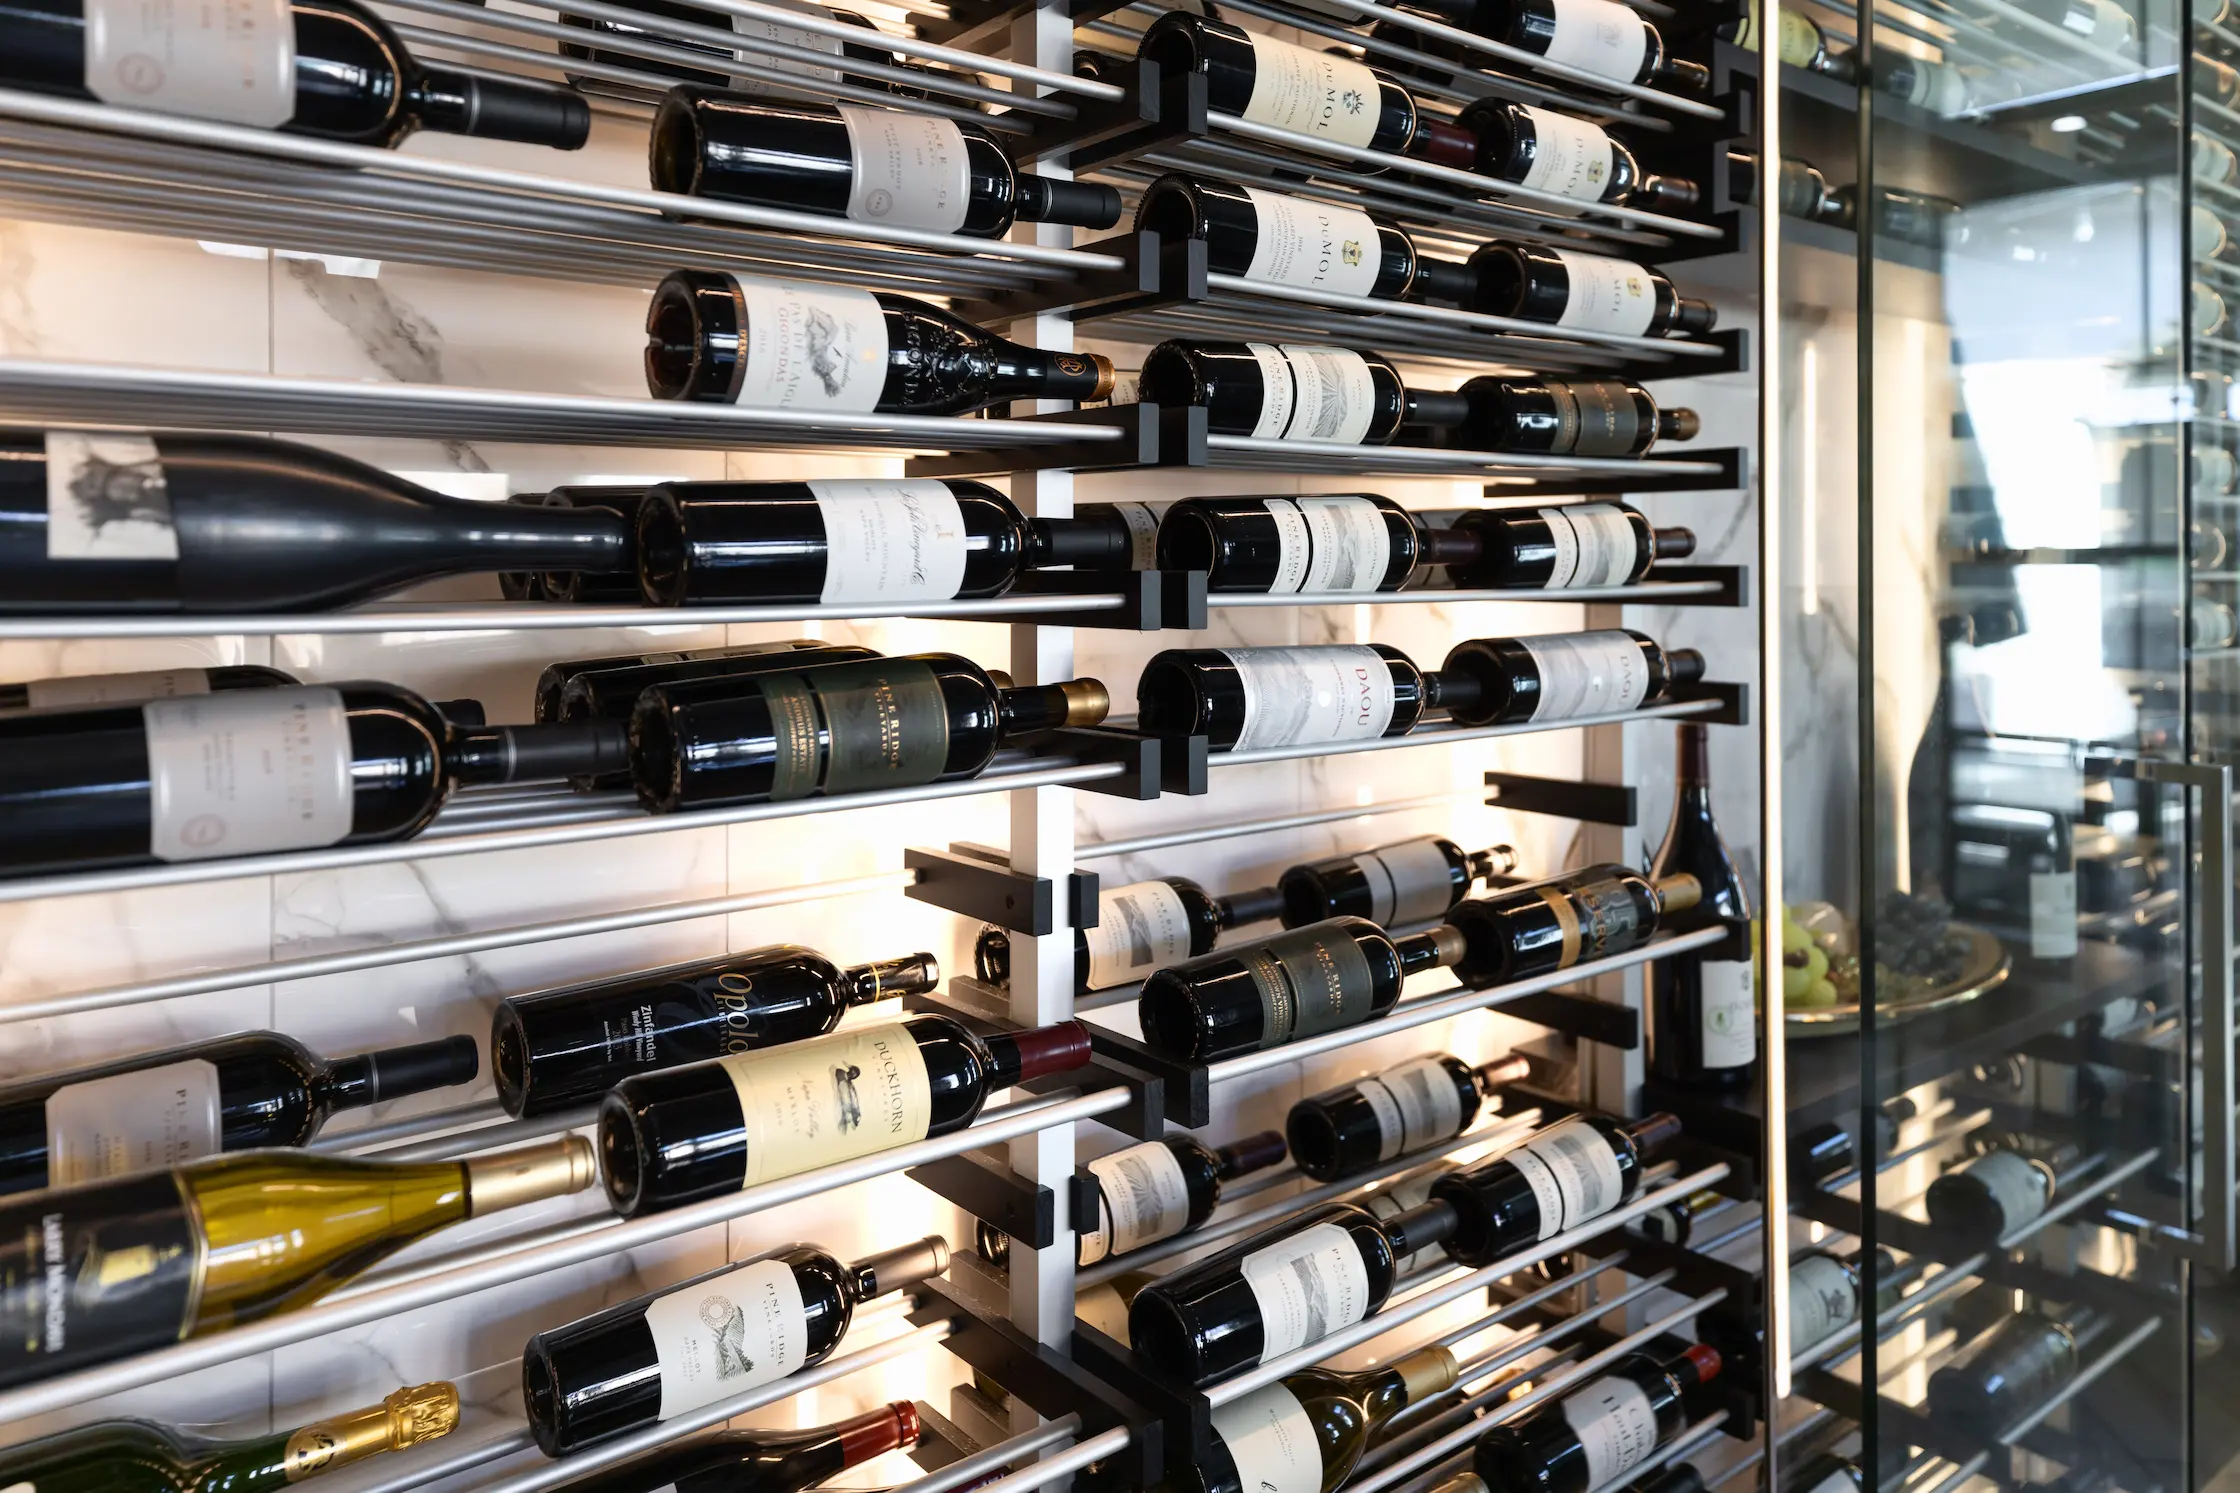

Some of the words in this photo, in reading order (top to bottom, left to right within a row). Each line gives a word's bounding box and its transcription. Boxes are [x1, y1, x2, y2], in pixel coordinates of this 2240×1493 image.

[1285, 84, 1301, 125] SAUVIGNON
[927, 121, 945, 150] PINE
[1311, 215, 1332, 285] DuMOL
[775, 308, 790, 384] GIGONDAS
[1270, 355, 1284, 383] PINE
[1271, 388, 1285, 426] RIDGE
[1286, 513, 1301, 542] PINE
[878, 539, 889, 591] MOUNTAIN
[1288, 547, 1302, 585] RIDGE
[1355, 669, 1372, 726] DAOU
[1618, 655, 1633, 706] DAOU
[790, 697, 807, 736] ANDRUS
[873, 692, 888, 757] VINEYARDS
[878, 679, 896, 714] PINE
[888, 719, 901, 771] RIDGE
[797, 738, 808, 775] ESTATE
[1266, 970, 1282, 999] CROWN
[1314, 942, 1335, 970] PINE
[1332, 973, 1343, 1015] RIDGE
[1315, 953, 1335, 1006] VINEYARDS
[631, 1009, 642, 1027] Windy
[640, 1004, 657, 1062] Zinfandel
[713, 972, 760, 1055] Opolo
[612, 1029, 623, 1051] 203
[634, 1038, 645, 1062] Vineyard
[872, 1056, 889, 1124] VINEYARDS
[873, 1041, 904, 1133] DUCKHORN
[785, 1085, 800, 1134] MERLOT
[804, 1100, 820, 1139] Valley
[1332, 1248, 1350, 1281] PINE
[1277, 1273, 1293, 1310] CABERNET
[765, 1282, 782, 1318] PINE
[775, 1323, 787, 1368] RIDGE
[691, 1339, 701, 1374] MEOT
